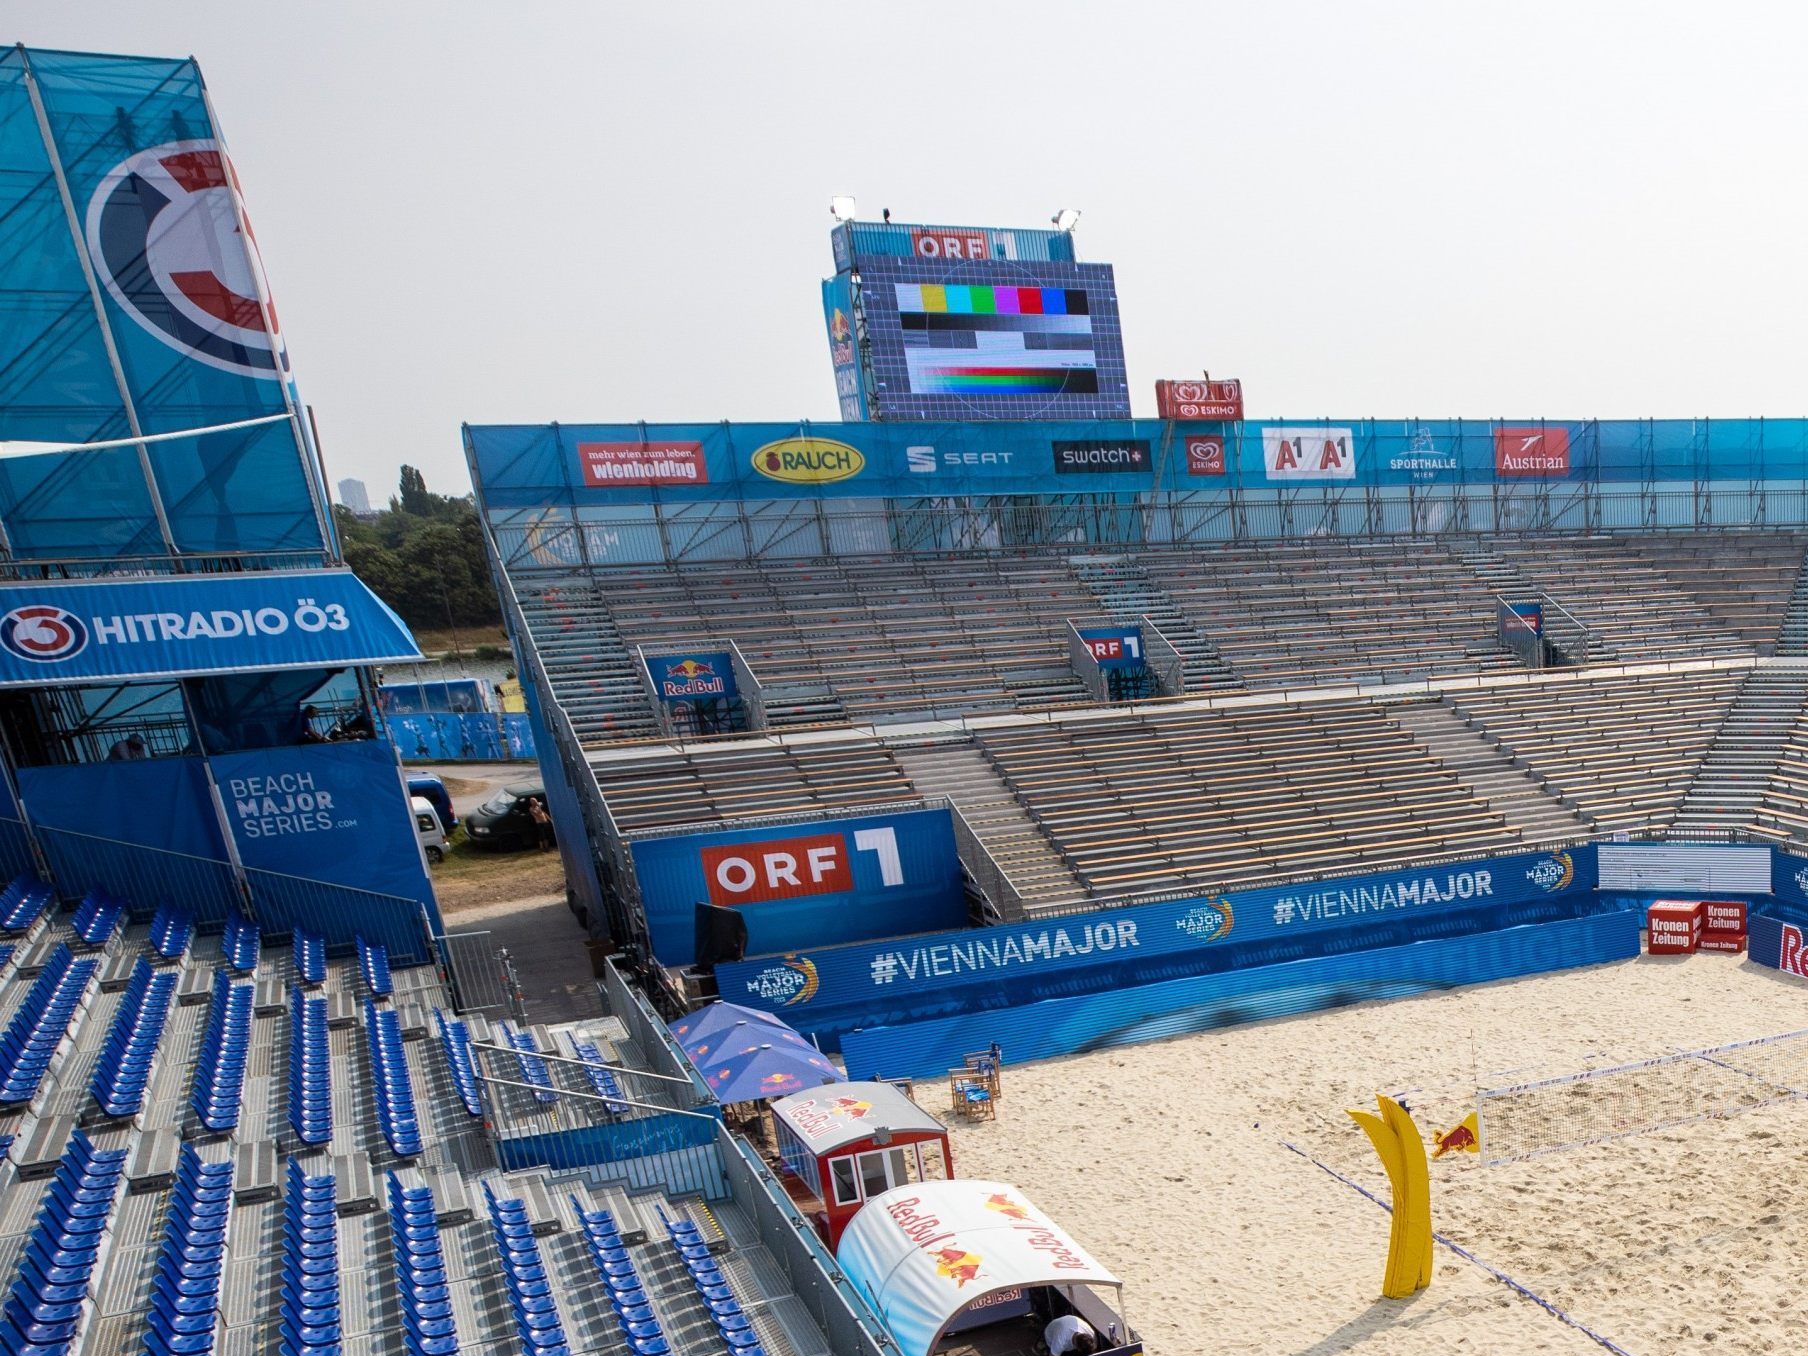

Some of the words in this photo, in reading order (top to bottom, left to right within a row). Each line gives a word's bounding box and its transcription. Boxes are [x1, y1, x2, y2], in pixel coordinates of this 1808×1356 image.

[918, 237, 983, 258] ORF
[1201, 406, 1235, 416] ESKIMO
[589, 451, 615, 459] mehr
[617, 450, 642, 458] wien
[666, 449, 695, 458] leben.
[783, 451, 851, 471] RAUCH
[944, 452, 1013, 464] SEAT
[1063, 448, 1130, 464] swatch
[1275, 436, 1302, 470] A1
[1320, 436, 1347, 470] A1
[1502, 452, 1564, 470] Austrian
[1192, 460, 1220, 470] ESKIMO
[1391, 459, 1456, 469] SPORTHALLE
[94, 608, 290, 645] HITRADIO
[295, 598, 349, 633] Ö3
[1124, 637, 1140, 657] 1
[230, 773, 315, 798] BEACH
[237, 791, 334, 818] MAJOR
[716, 846, 838, 894] ORF
[853, 827, 905, 888] 1
[1526, 865, 1565, 879] MAJOR
[1272, 870, 1494, 925] #VIENNAMAJOR
[1707, 905, 1740, 917] Kronen
[1175, 913, 1224, 930] MAJOR
[1186, 924, 1216, 935] SERIES
[1652, 918, 1689, 932] Kronen
[1708, 917, 1740, 931] Zeitung
[1652, 932, 1690, 947] Zeitung
[1701, 941, 1719, 949] Kronen
[1720, 941, 1738, 950] Zeitung
[870, 919, 1140, 986] #VIENNAMAJOR
[746, 974, 806, 993] MAJOR
[760, 986, 796, 998] SERIES
